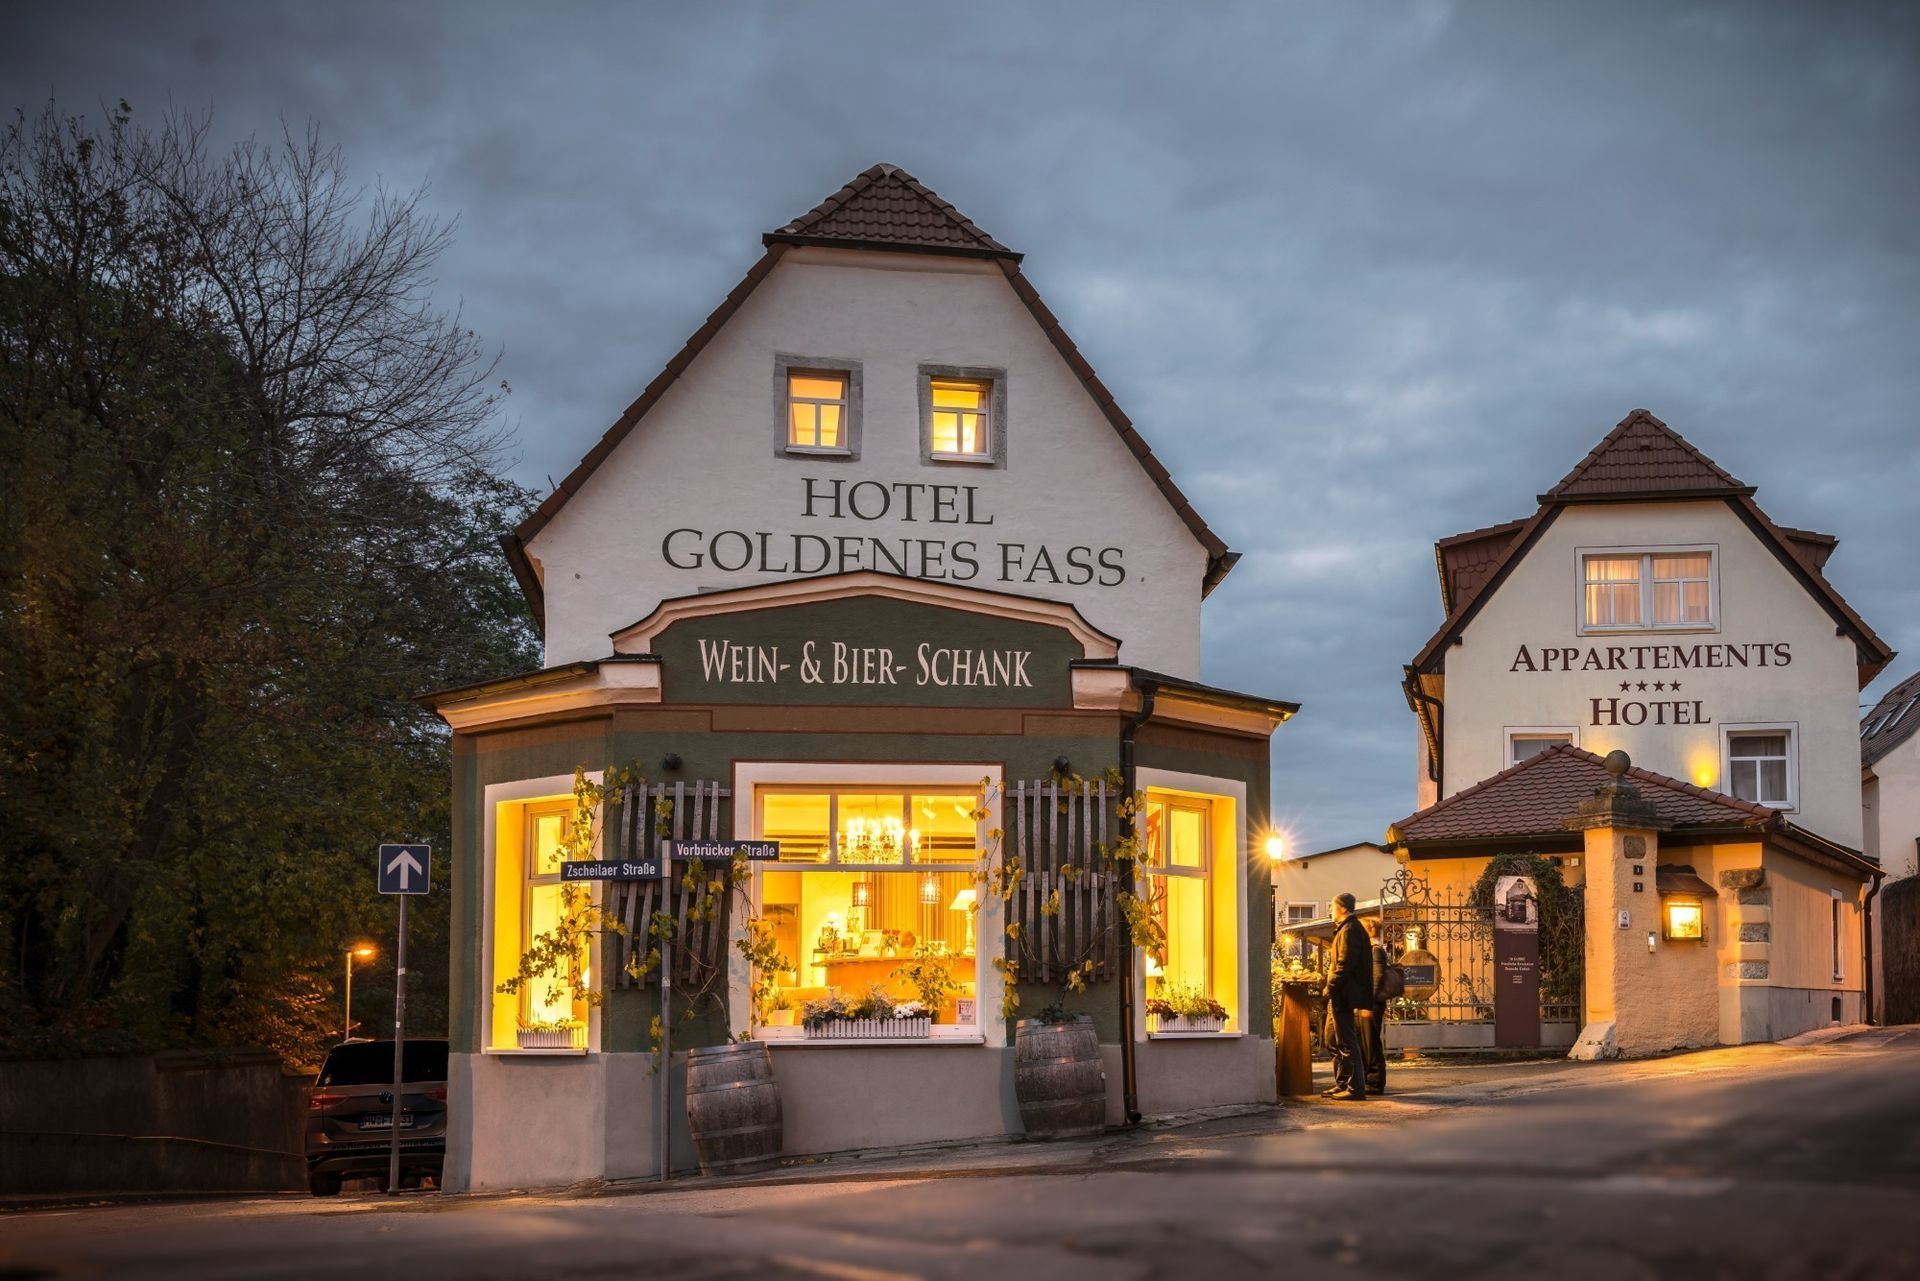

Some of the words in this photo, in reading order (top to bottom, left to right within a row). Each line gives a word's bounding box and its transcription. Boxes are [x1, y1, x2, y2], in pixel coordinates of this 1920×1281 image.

[800, 477, 994, 525] HOTEL
[661, 528, 980, 581] GOLDENES
[996, 542, 1126, 587] FASS
[697, 639, 791, 683] WEIN-
[799, 640, 825, 684] &
[831, 641, 907, 685] BIER-
[915, 642, 1033, 687] SCHANK
[1508, 642, 1793, 673] APPARTEMENTS
[1589, 697, 1712, 726] HOTEL
[676, 842, 736, 857] Vorbrücker
[740, 843, 776, 857] Straße
[566, 863, 618, 878] Zscheilaer
[622, 862, 656, 876] Straße
